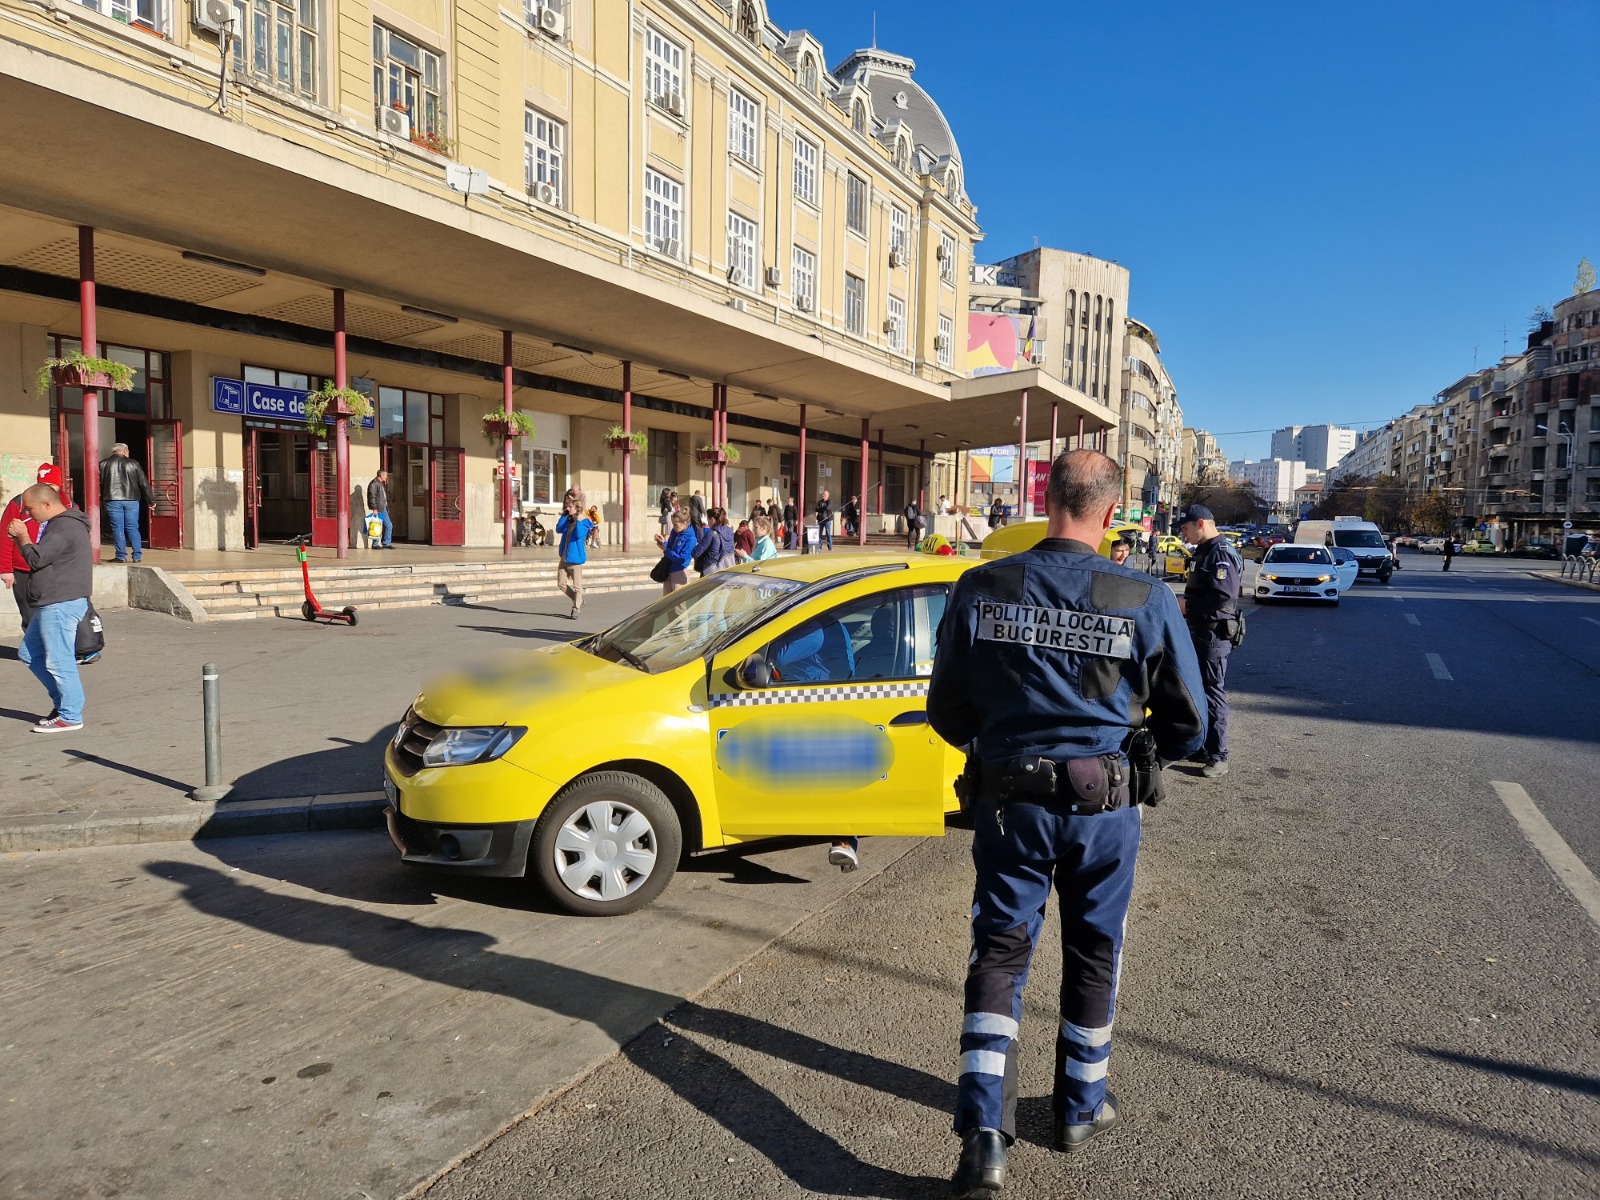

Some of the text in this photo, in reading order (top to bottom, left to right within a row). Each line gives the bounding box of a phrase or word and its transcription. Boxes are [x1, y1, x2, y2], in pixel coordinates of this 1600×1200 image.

[252, 391, 305, 415] Case de
[982, 604, 1131, 637] POLITIA LOCALA
[993, 624, 1114, 654] BUCURESTI
